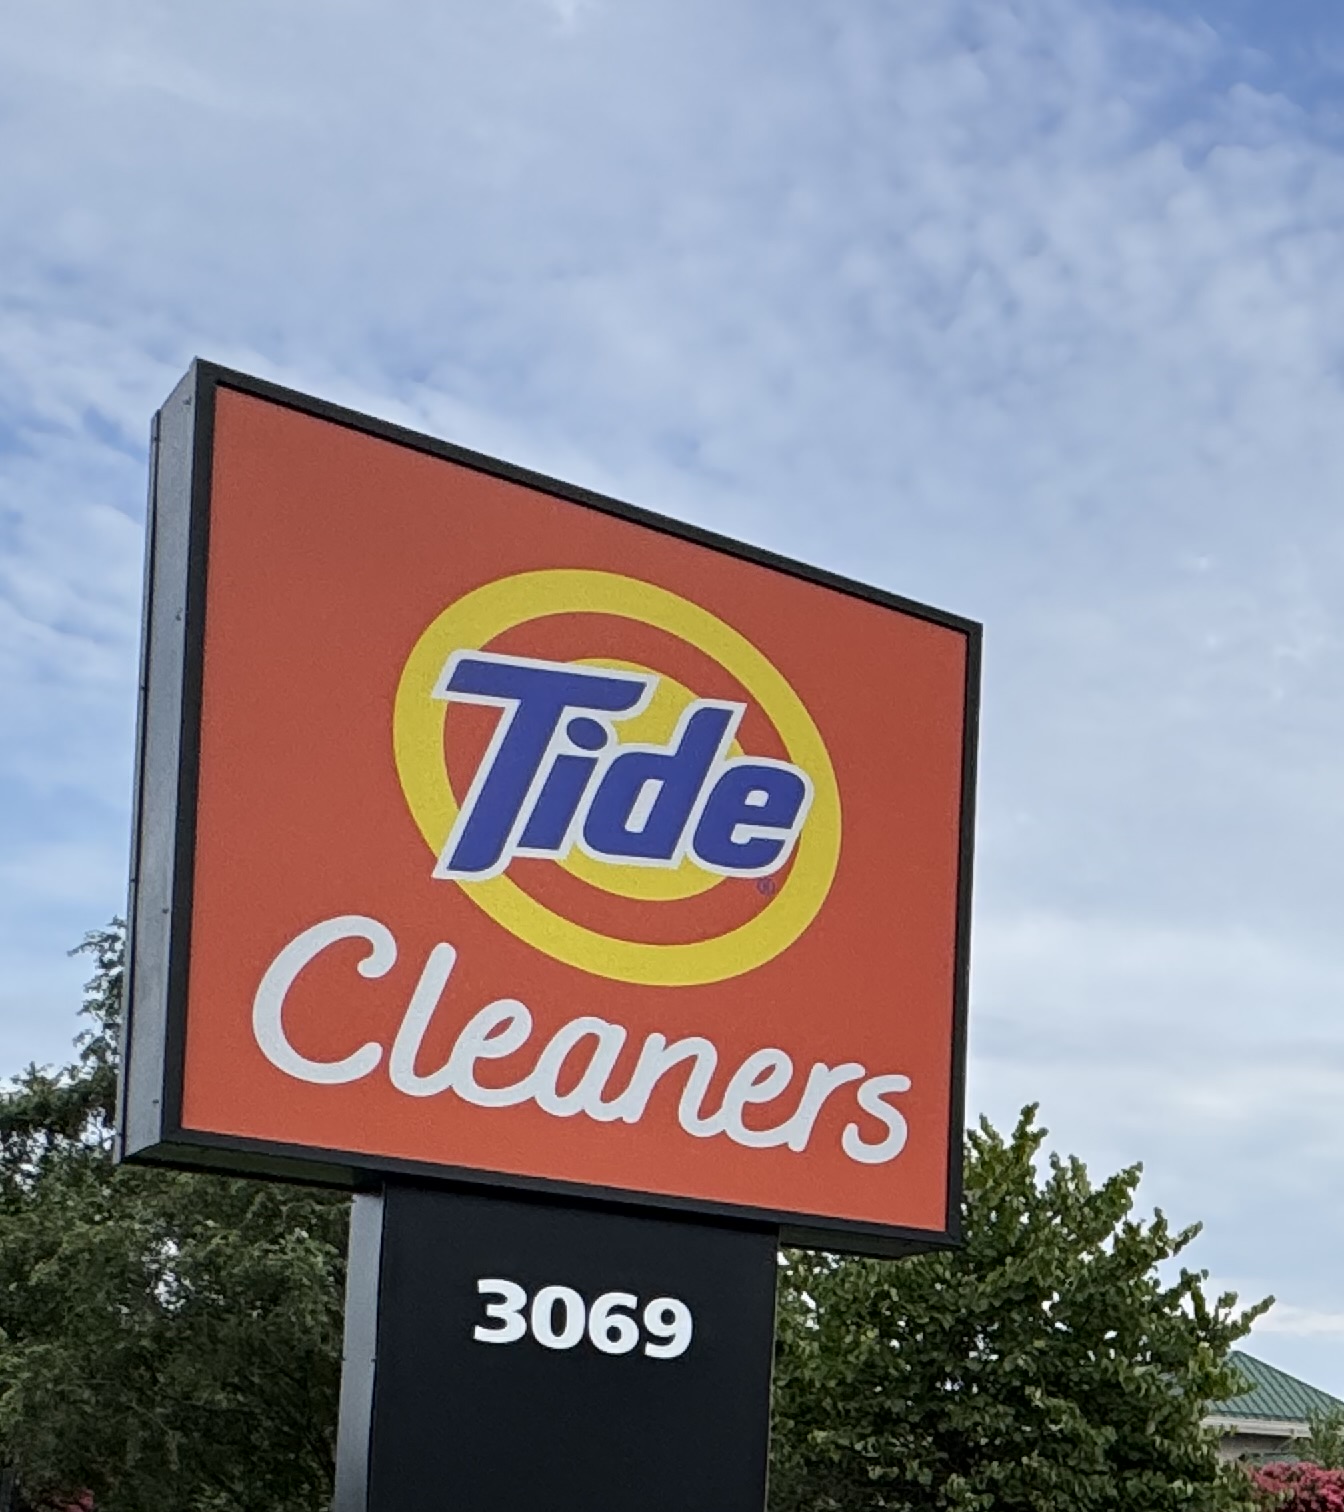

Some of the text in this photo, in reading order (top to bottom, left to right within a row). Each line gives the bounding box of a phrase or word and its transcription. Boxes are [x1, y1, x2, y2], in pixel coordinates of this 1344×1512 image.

[432, 649, 814, 881] Tide
[252, 914, 912, 1164] Cleaners
[472, 1278, 693, 1357] 3069
